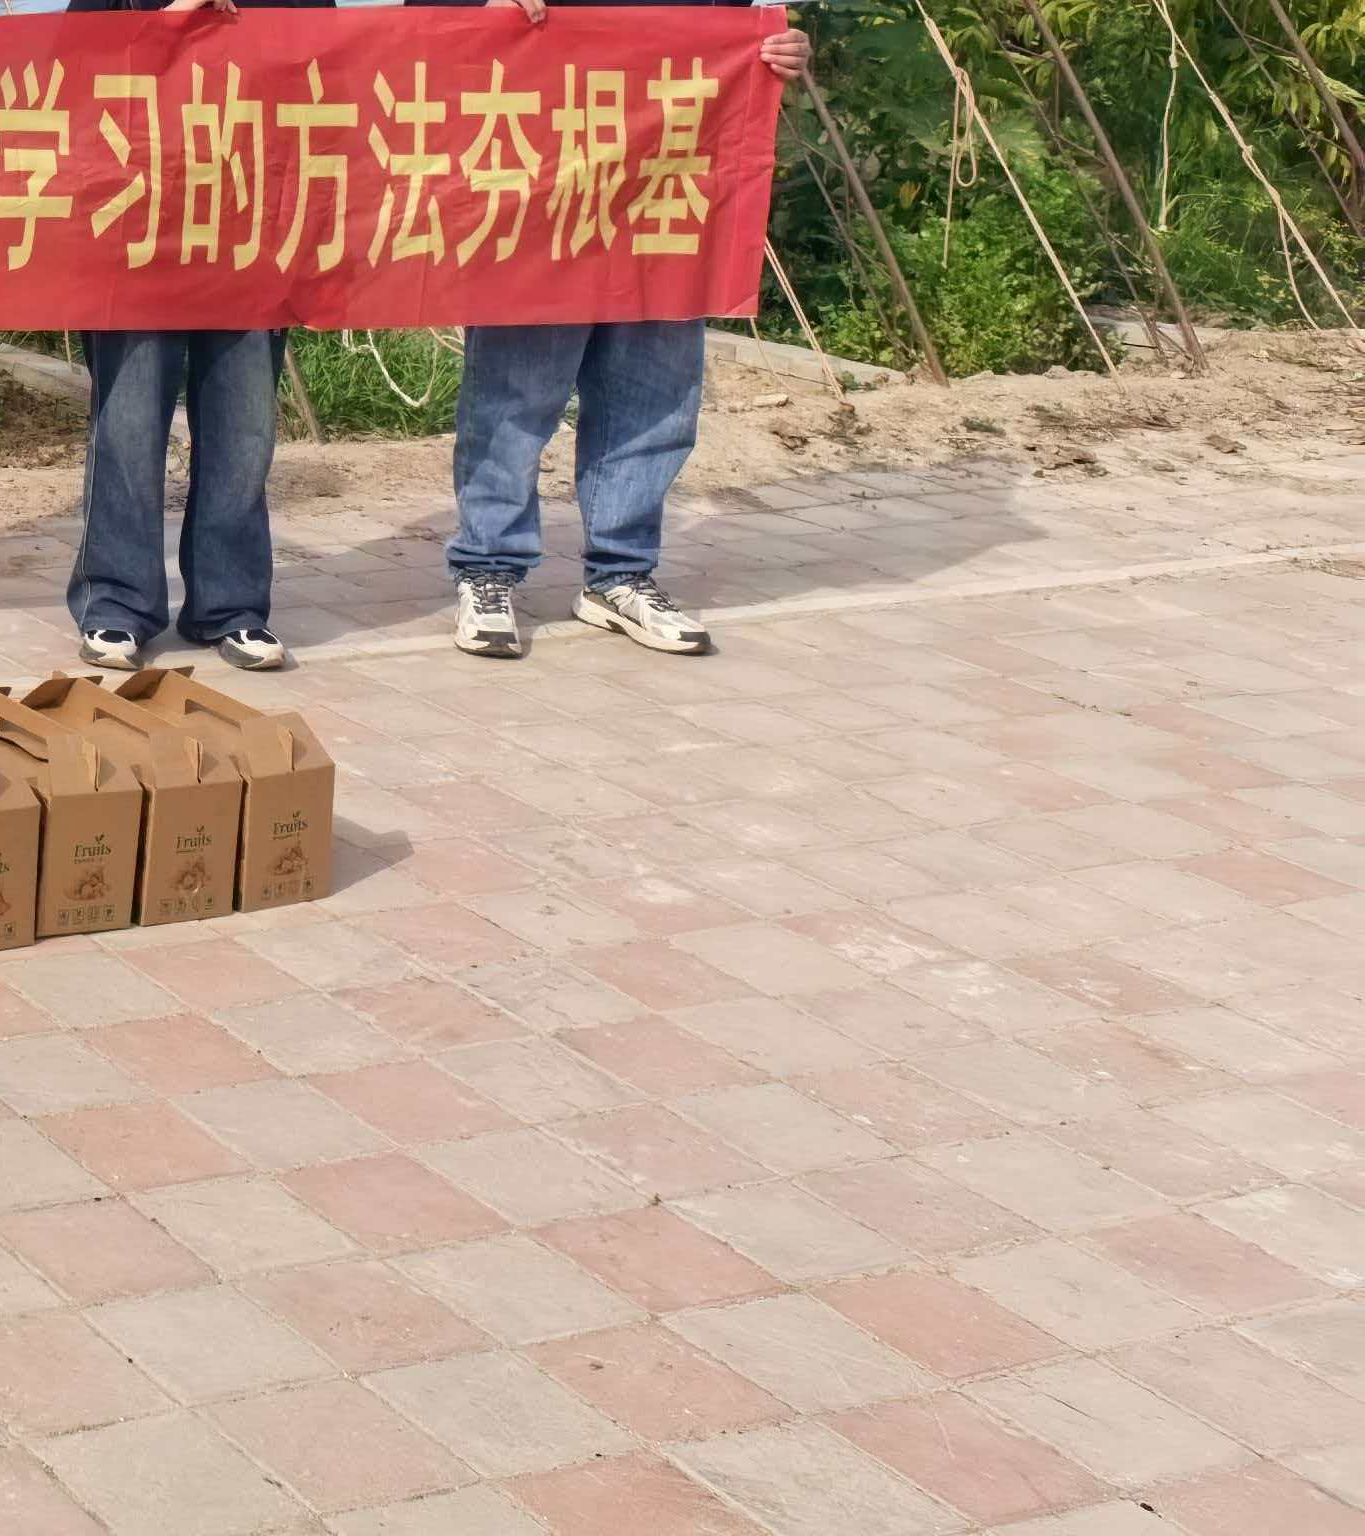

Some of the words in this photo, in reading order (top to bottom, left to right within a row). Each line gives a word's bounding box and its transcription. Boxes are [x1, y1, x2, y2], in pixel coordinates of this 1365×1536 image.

[273, 817, 309, 835] Fruits
[176, 832, 212, 849] Fruits
[73, 842, 112, 859] Fruits
